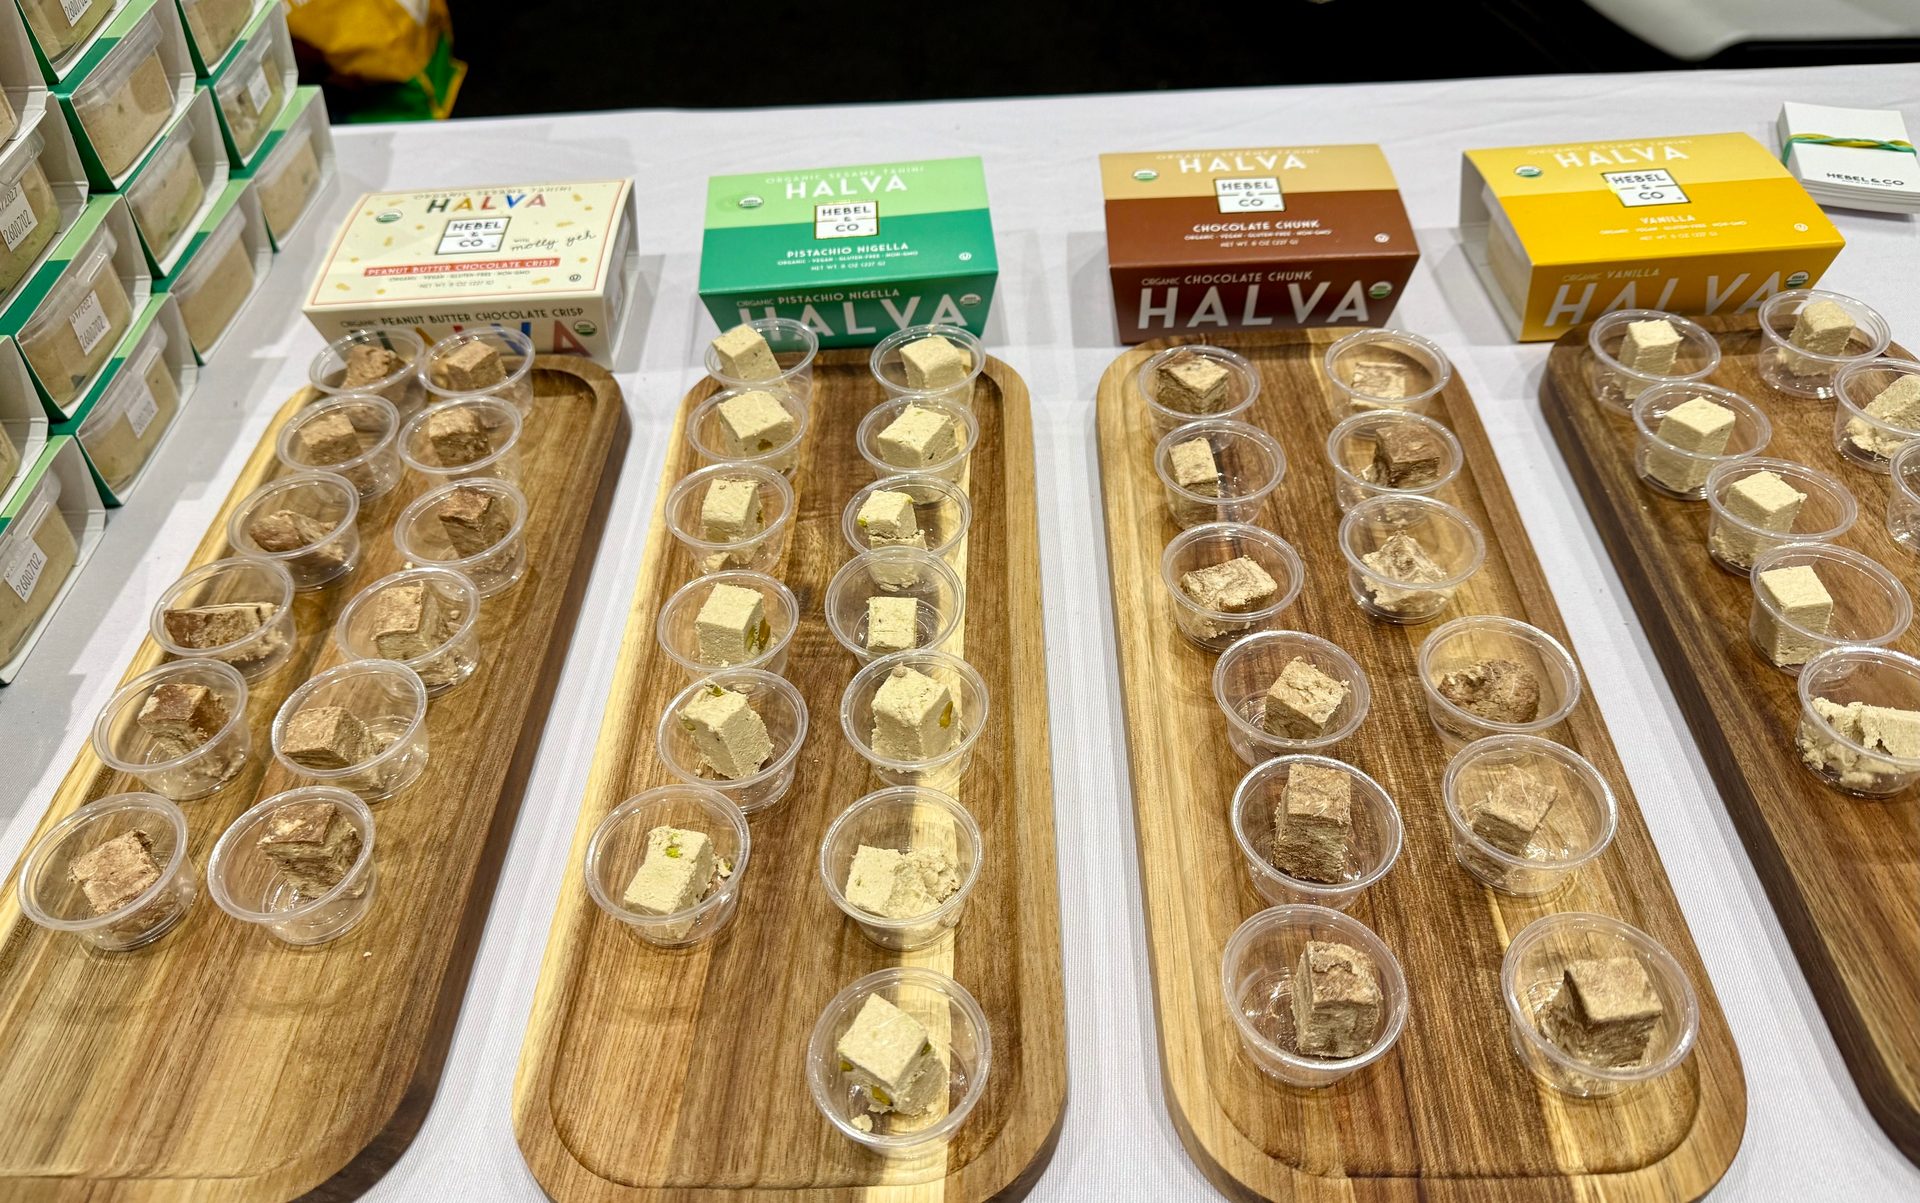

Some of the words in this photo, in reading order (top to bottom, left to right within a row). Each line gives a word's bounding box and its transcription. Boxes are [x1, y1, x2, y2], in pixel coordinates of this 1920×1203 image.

[1179, 154, 1307, 174] HALVA
[1554, 146, 1689, 168] HALVA
[830, 170, 875, 179] SESAME
[1611, 174, 1666, 184] HEBEL
[1826, 173, 1869, 182] HEBEL
[786, 174, 908, 200] HALVA
[1221, 182, 1274, 190] HEBEL
[426, 193, 546, 214] HALVA
[1239, 198, 1264, 207] CO
[1638, 191, 1664, 200] CO
[822, 206, 871, 216] HEBEL
[3, 209, 32, 245] 2600702
[453, 221, 502, 231] HEBEL
[1193, 223, 1270, 233] CHOCOLATE
[1276, 220, 1320, 230] CHUNK
[1640, 215, 1696, 224] VANILLA
[835, 224, 859, 232] CO
[459, 240, 482, 248] CO
[512, 239, 557, 252] molly
[567, 230, 596, 246] yeh
[787, 247, 852, 258] PISTACHIO
[857, 242, 908, 254] NIGELLA
[368, 266, 410, 276] PEANUT
[412, 264, 450, 273] BUTTER
[455, 262, 521, 271] CHOCOLATE
[525, 259, 556, 267] CRISP
[1607, 268, 1660, 279] VANILLA
[1141, 278, 1180, 286] ORGANIC
[1184, 273, 1263, 285] CHOCOLATE
[1268, 270, 1313, 282] CHUNK
[736, 298, 774, 308] ORGANIC
[778, 293, 844, 304] PISTACHIO
[848, 288, 900, 299] NIGELLA
[1138, 280, 1369, 329] HALVA
[380, 316, 424, 326] PEANUT
[429, 313, 471, 324] BUTTER
[476, 310, 548, 322] CHOCOLATE
[552, 308, 584, 318] CRISP
[738, 294, 968, 341] HALVA
[16, 552, 42, 597] 2600702
